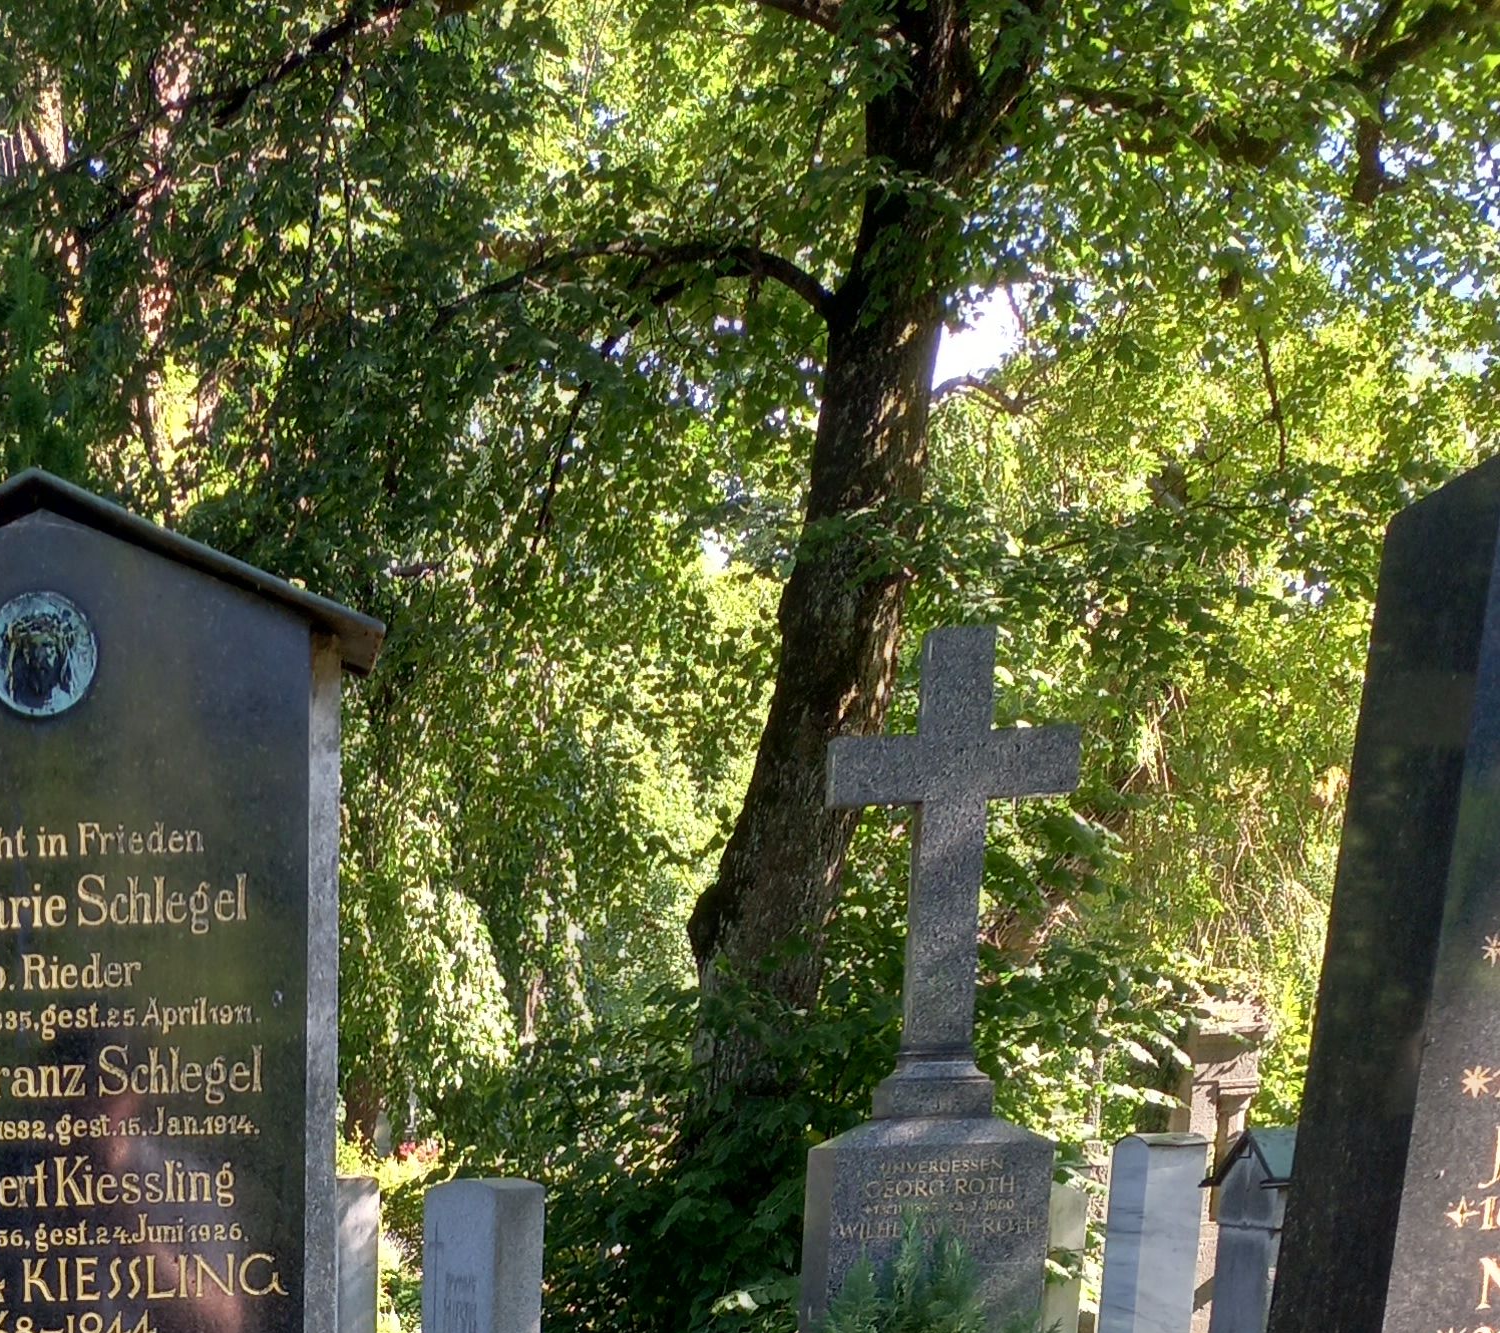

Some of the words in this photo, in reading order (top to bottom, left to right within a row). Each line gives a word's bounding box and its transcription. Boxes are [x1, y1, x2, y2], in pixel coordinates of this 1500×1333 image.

[38, 825, 68, 857] in
[76, 821, 204, 855] Frieden
[77, 873, 248, 934] Schlegel
[21, 952, 142, 990] Rieder
[98, 1043, 264, 1104] Schlegel
[53, 1155, 236, 1210] Kiessling
[864, 1177, 946, 1199] GEORG
[954, 1175, 1016, 1195] ROTH
[22, 1251, 289, 1303] KIESSLING
